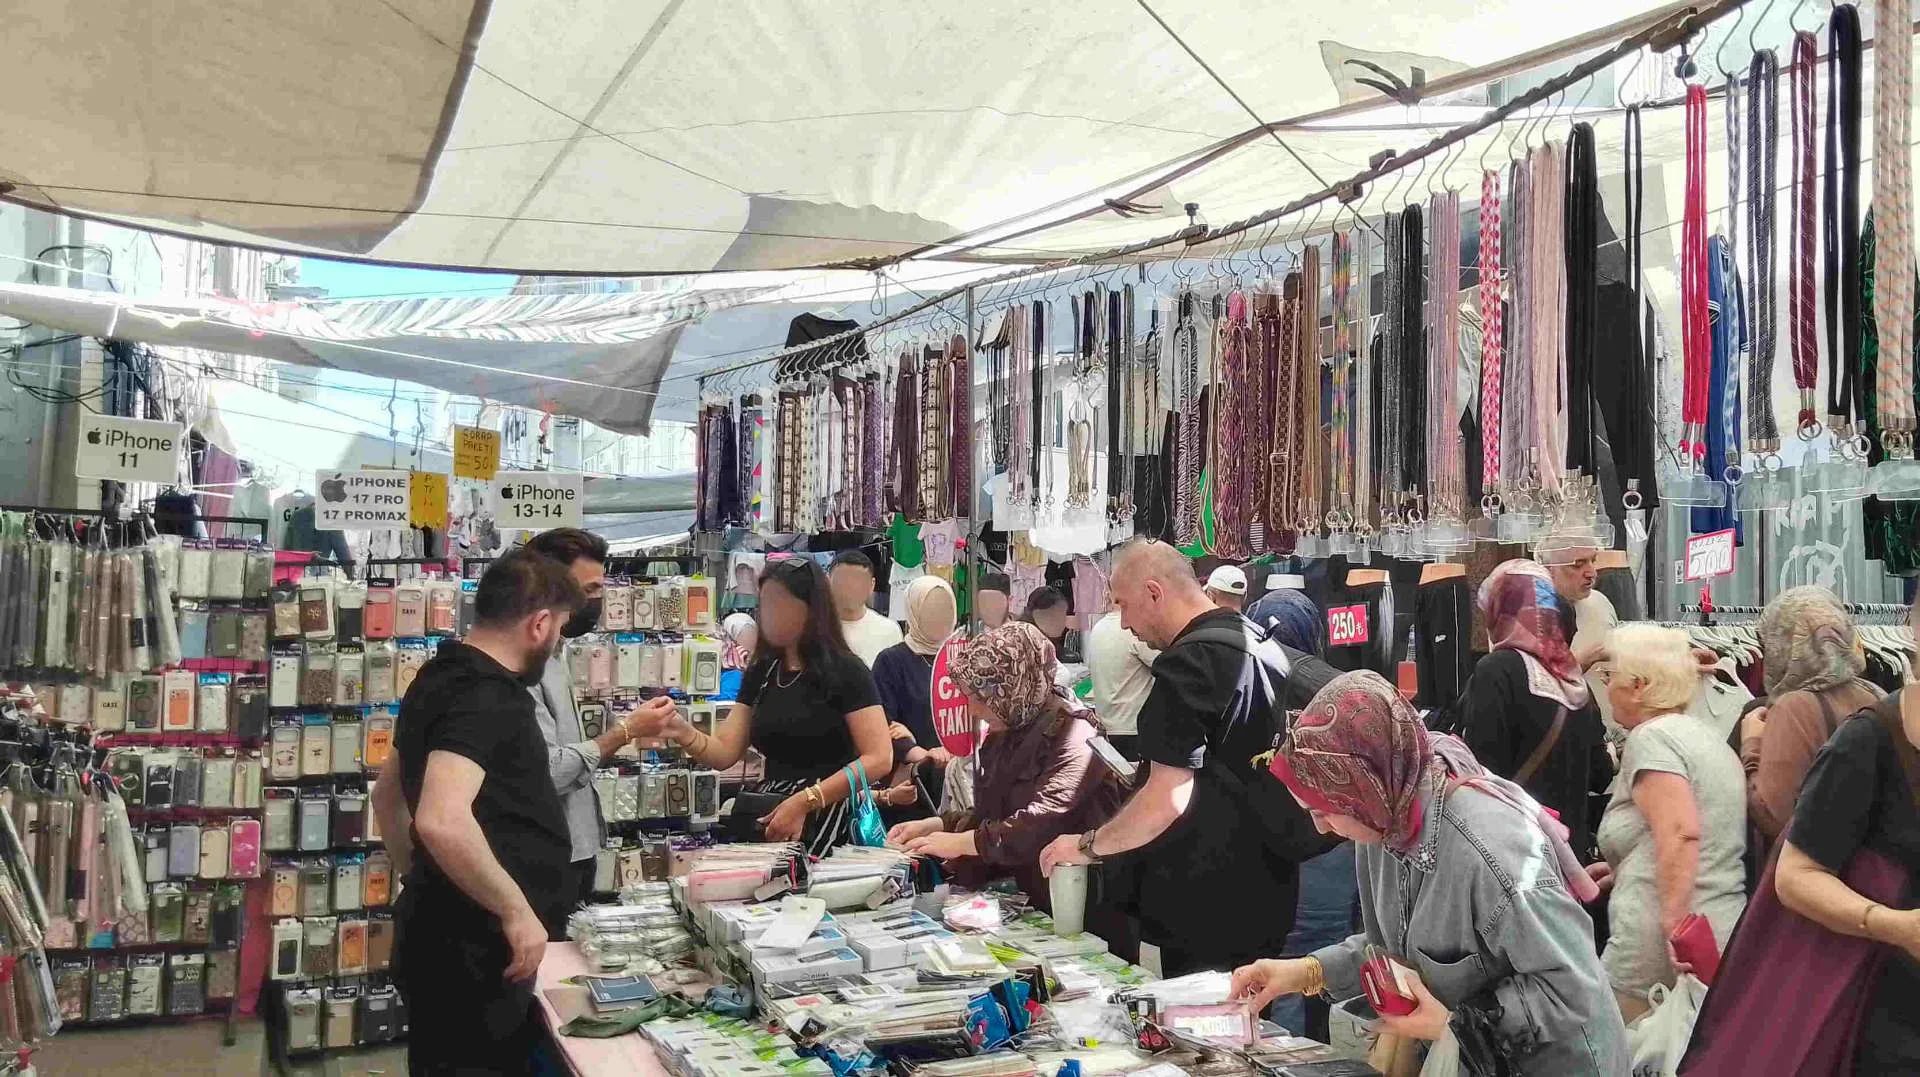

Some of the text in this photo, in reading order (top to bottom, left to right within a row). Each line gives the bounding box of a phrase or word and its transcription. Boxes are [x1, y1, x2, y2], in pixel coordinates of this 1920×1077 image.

[105, 429, 172, 451] iPhone
[118, 452, 139, 468] 11
[350, 477, 406, 488] IPHONE
[353, 494, 404, 505] 17 PRO
[517, 484, 575, 500] iPhone
[323, 510, 406, 521] 17 PROMAX
[513, 503, 563, 518] 13-14
